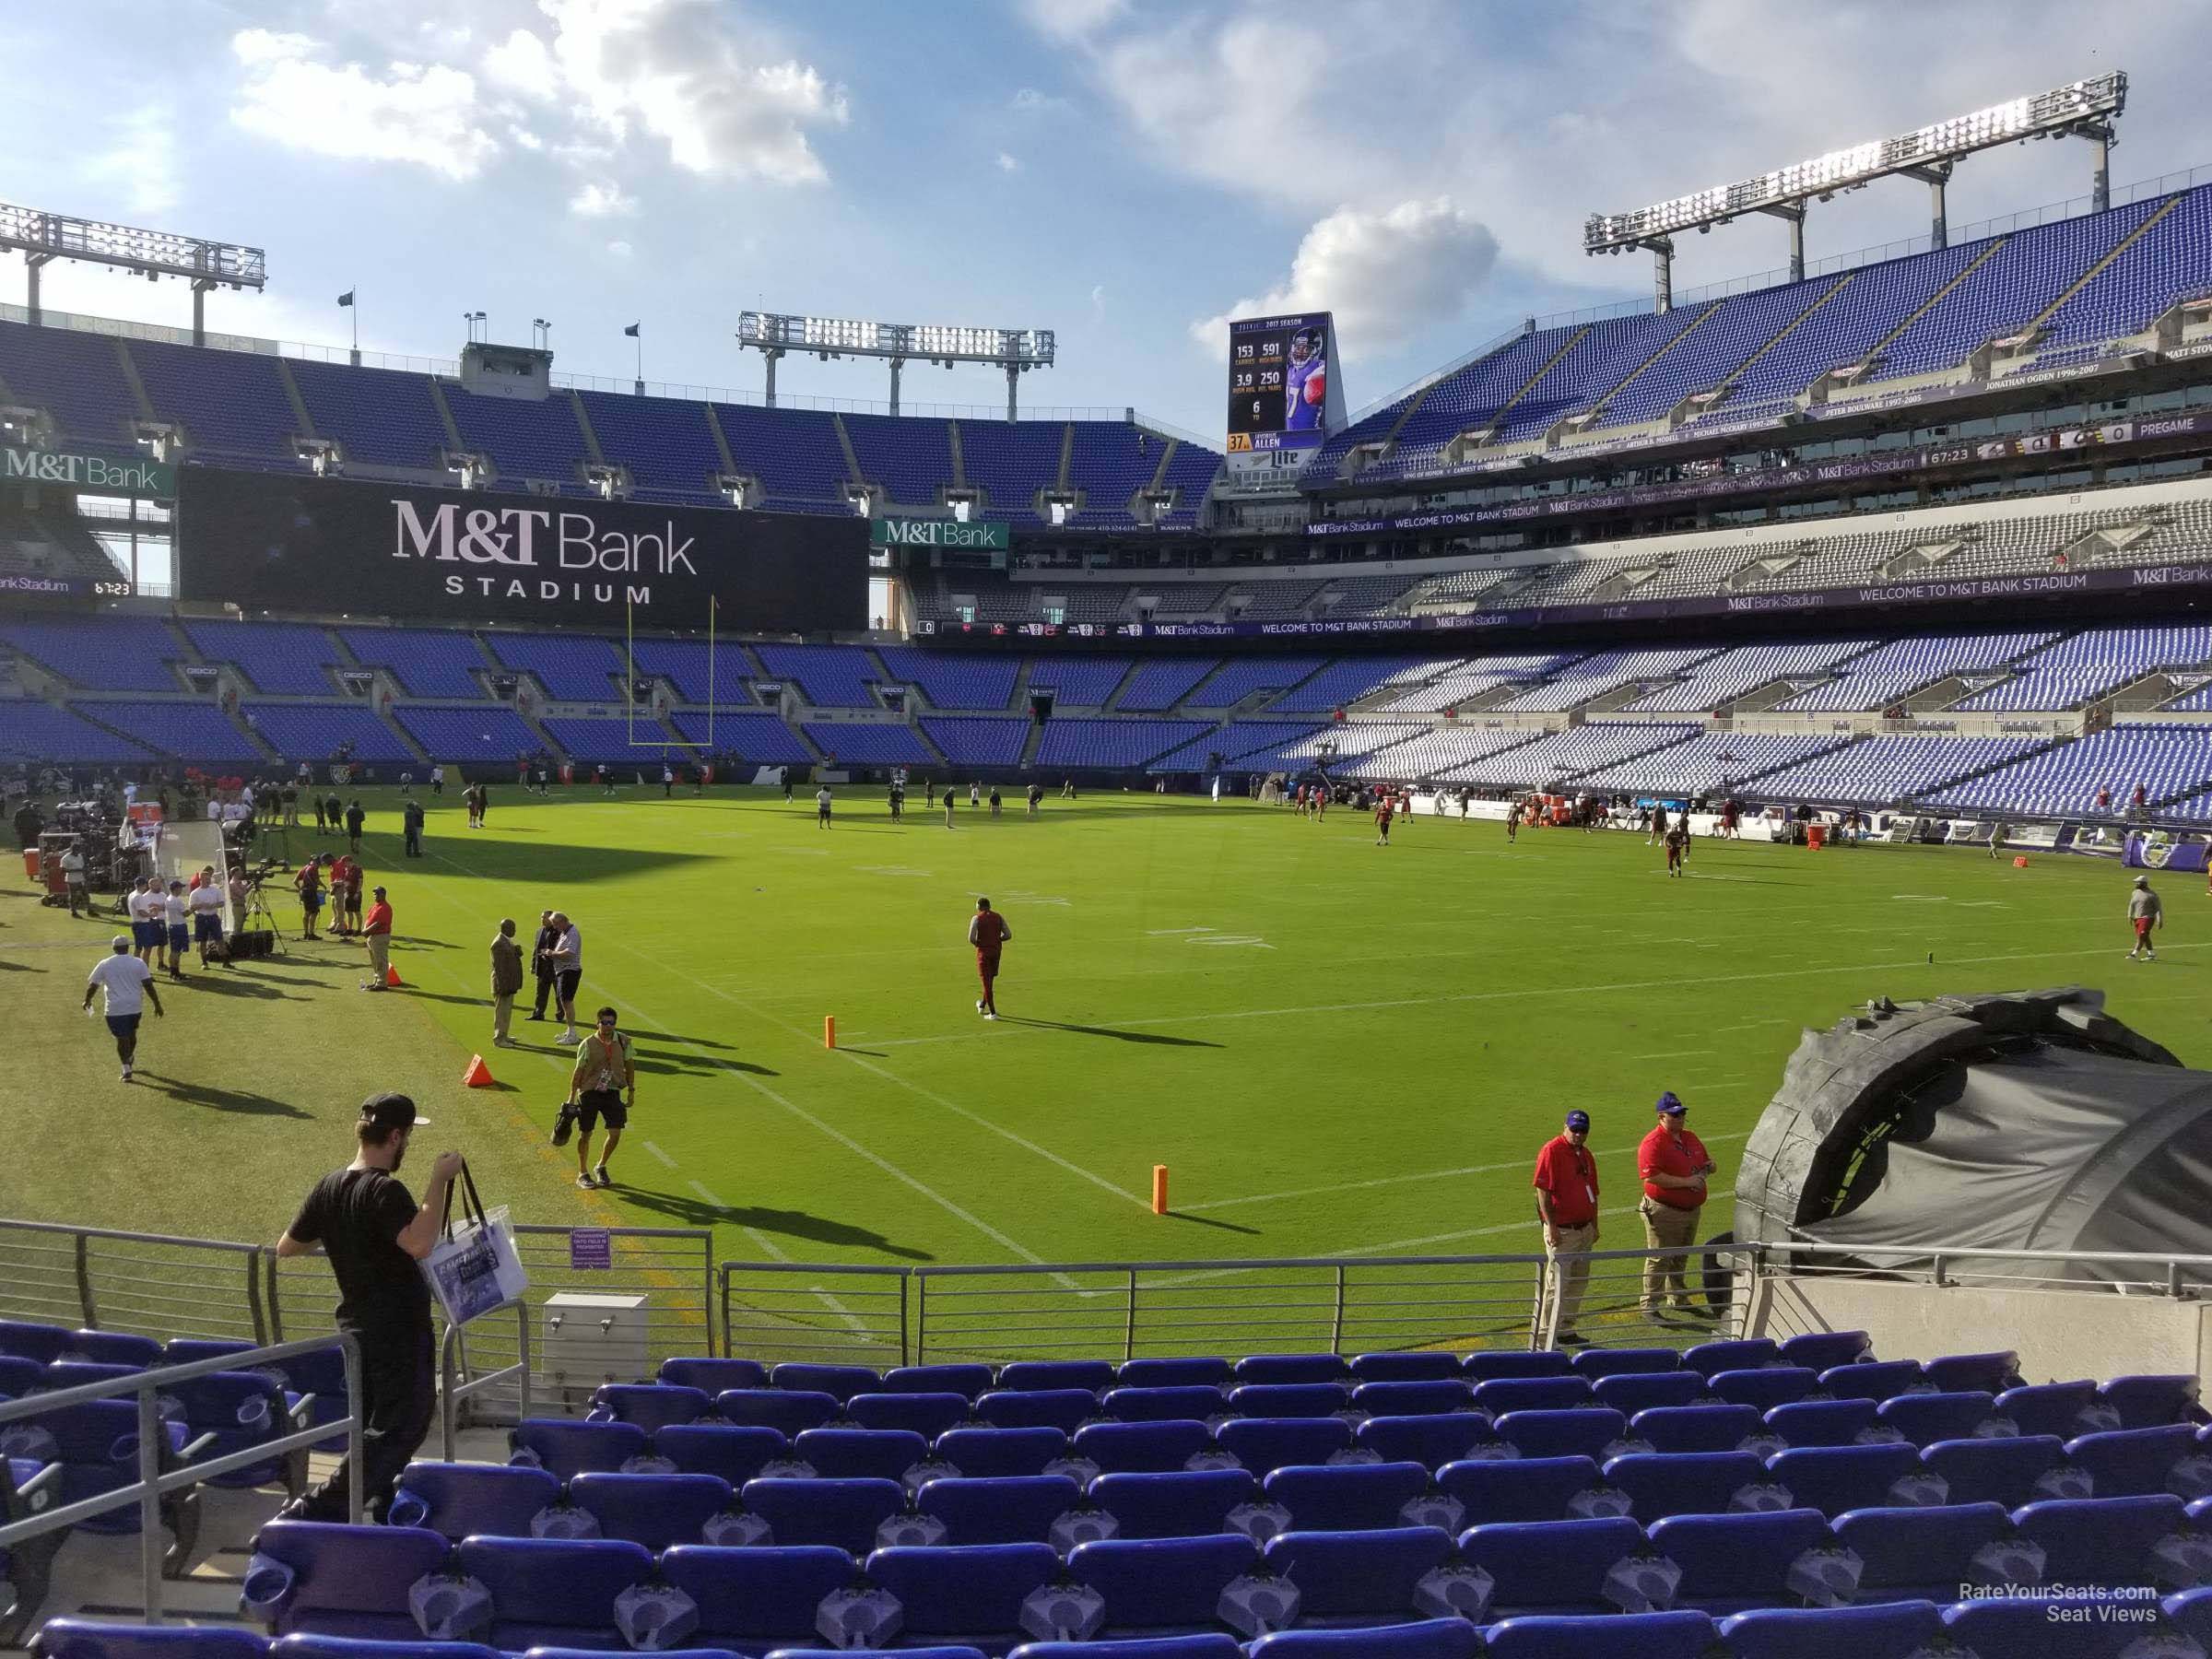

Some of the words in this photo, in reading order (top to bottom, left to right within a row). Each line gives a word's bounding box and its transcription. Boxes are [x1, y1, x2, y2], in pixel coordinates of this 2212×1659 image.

[1265, 320, 1279, 328] 2017
[1279, 318, 1302, 327] SEASON
[1237, 345, 1253, 359] 153
[1262, 343, 1279, 357] 591
[2165, 347, 2189, 359] MATT
[1237, 373, 1253, 386] 3.9
[1260, 371, 1280, 385] 250
[1984, 376, 2026, 391] JONATHAN
[2027, 371, 2054, 384] OGDEN
[2056, 364, 2100, 380] 1996-2007
[1253, 401, 1260, 414] 6
[1825, 406, 1845, 418] PETER
[1847, 402, 1883, 414] BOULWARE
[1885, 394, 1922, 407] 1997-2005
[1693, 428, 1720, 438] MICHAEL
[2140, 418, 2194, 436] PREGAME
[1230, 435, 1243, 451] 37
[1254, 438, 1280, 449] ALLEN
[1626, 439, 1648, 449] ARTHUR
[1656, 434, 1679, 444] MODELL
[1270, 451, 1299, 469] Lite
[1931, 449, 1969, 464] 67:23
[5, 448, 84, 482] M&T
[88, 457, 158, 489] Bank
[1425, 469, 1443, 477] HONOR
[1817, 465, 1844, 479] M&T
[1844, 463, 1870, 476] Bank
[1871, 458, 1914, 473] Stadium
[1549, 500, 1570, 514] M&T
[1570, 500, 1590, 511] Bank
[1590, 495, 1625, 509] Stadium
[1394, 515, 1439, 529] WELCOME
[1441, 514, 1453, 524] TO
[1455, 512, 1475, 523] M&T
[1477, 509, 1500, 521] BANK
[1501, 505, 1539, 519] STADIUM
[885, 521, 942, 544] M&T
[944, 523, 996, 546] Bank
[1308, 524, 1329, 535] M&T
[1329, 523, 1350, 533] Bank
[1349, 521, 1383, 532] Stadium
[391, 500, 550, 566] M&T
[559, 512, 698, 575] Bank
[2133, 569, 2172, 584] M&T
[2171, 565, 2208, 582] Bank
[18, 577, 69, 593] Stadium
[444, 575, 651, 604] STADIUM
[1859, 586, 1924, 601] WELCOME
[1927, 584, 1946, 596] TO
[1949, 582, 1979, 596] M&T
[1982, 579, 2019, 594] BANK
[2022, 574, 2087, 591] STADIUM
[1728, 597, 1754, 611] M&T
[1754, 595, 1780, 609] Bank
[1780, 594, 1823, 607] Stadium
[1261, 623, 1308, 633] WELCOME
[1310, 623, 1324, 632] TO
[1324, 622, 1345, 631] M&T
[1347, 621, 1371, 630] BANK
[1372, 619, 1412, 629] STADIUM
[1436, 617, 1454, 629] M&T
[1455, 616, 1475, 627] Bank
[1475, 614, 1508, 626] Stadium
[1155, 625, 1178, 635] M&T
[1178, 625, 1199, 635] Bank
[1199, 625, 1234, 635] Stadium
[186, 666, 218, 675] GEICO
[343, 671, 372, 679] GEICO
